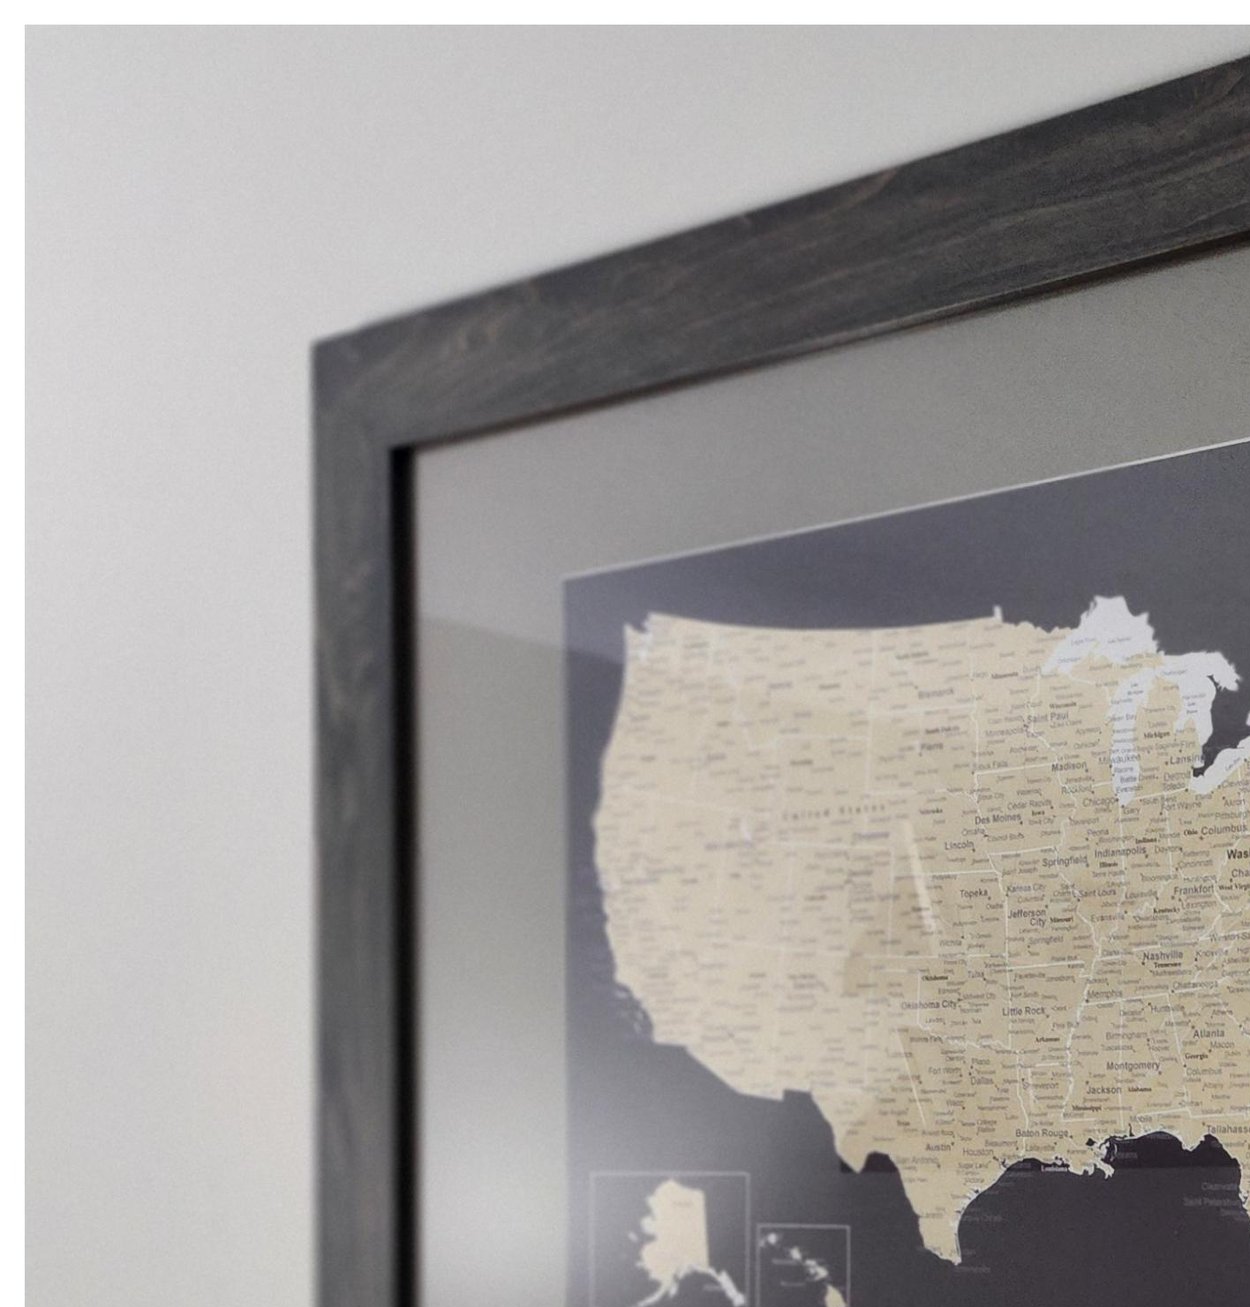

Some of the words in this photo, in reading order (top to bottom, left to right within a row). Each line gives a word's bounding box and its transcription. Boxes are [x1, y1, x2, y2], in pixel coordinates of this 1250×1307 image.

[1051, 762, 1087, 772] Madison
[975, 815, 990, 825] Des
[992, 814, 1021, 823] Moines
[1201, 824, 1248, 835] Columbus
[944, 841, 975, 851] Lincoln
[1095, 846, 1147, 858] Indianapolis
[1042, 855, 1088, 867] Springfield
[960, 888, 988, 899] Topeka
[1174, 884, 1214, 895] Frankfort
[1008, 909, 1046, 919] Jefferson
[1030, 918, 1046, 928] City
[1143, 951, 1184, 962] Nashville
[1002, 1008, 1022, 1017] Little
[1025, 1006, 1045, 1016] Rock
[1193, 1029, 1225, 1039] Atlanta
[1106, 1060, 1160, 1072] Montgomery
[1086, 1085, 1122, 1096] Jackson
[1015, 1128, 1040, 1138] Baton
[1041, 1128, 1069, 1139] Rouge
